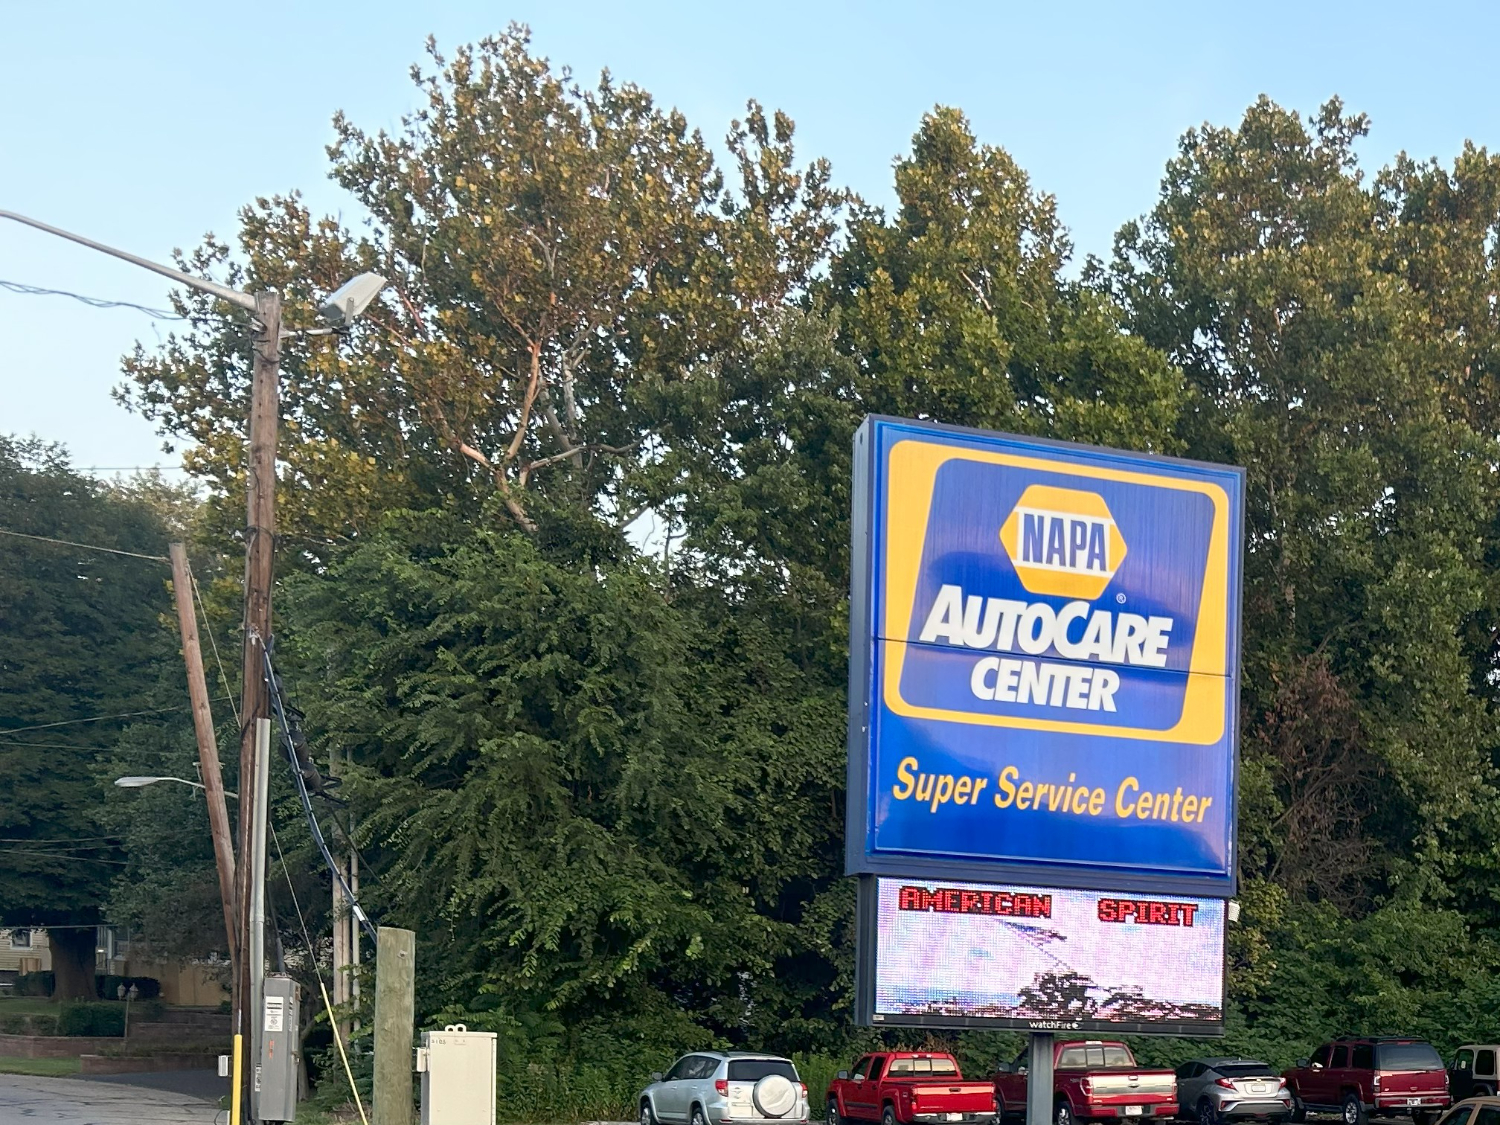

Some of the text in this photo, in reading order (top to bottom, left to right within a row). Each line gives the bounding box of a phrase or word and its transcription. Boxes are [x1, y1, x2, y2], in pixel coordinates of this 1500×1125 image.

[1022, 512, 1108, 573] NAPA
[919, 584, 1174, 668] AUTOCARE
[970, 656, 1121, 713] CENTER
[892, 756, 1212, 824] Super Service Center
[899, 885, 1199, 927] AMERICAN SPIRIT
